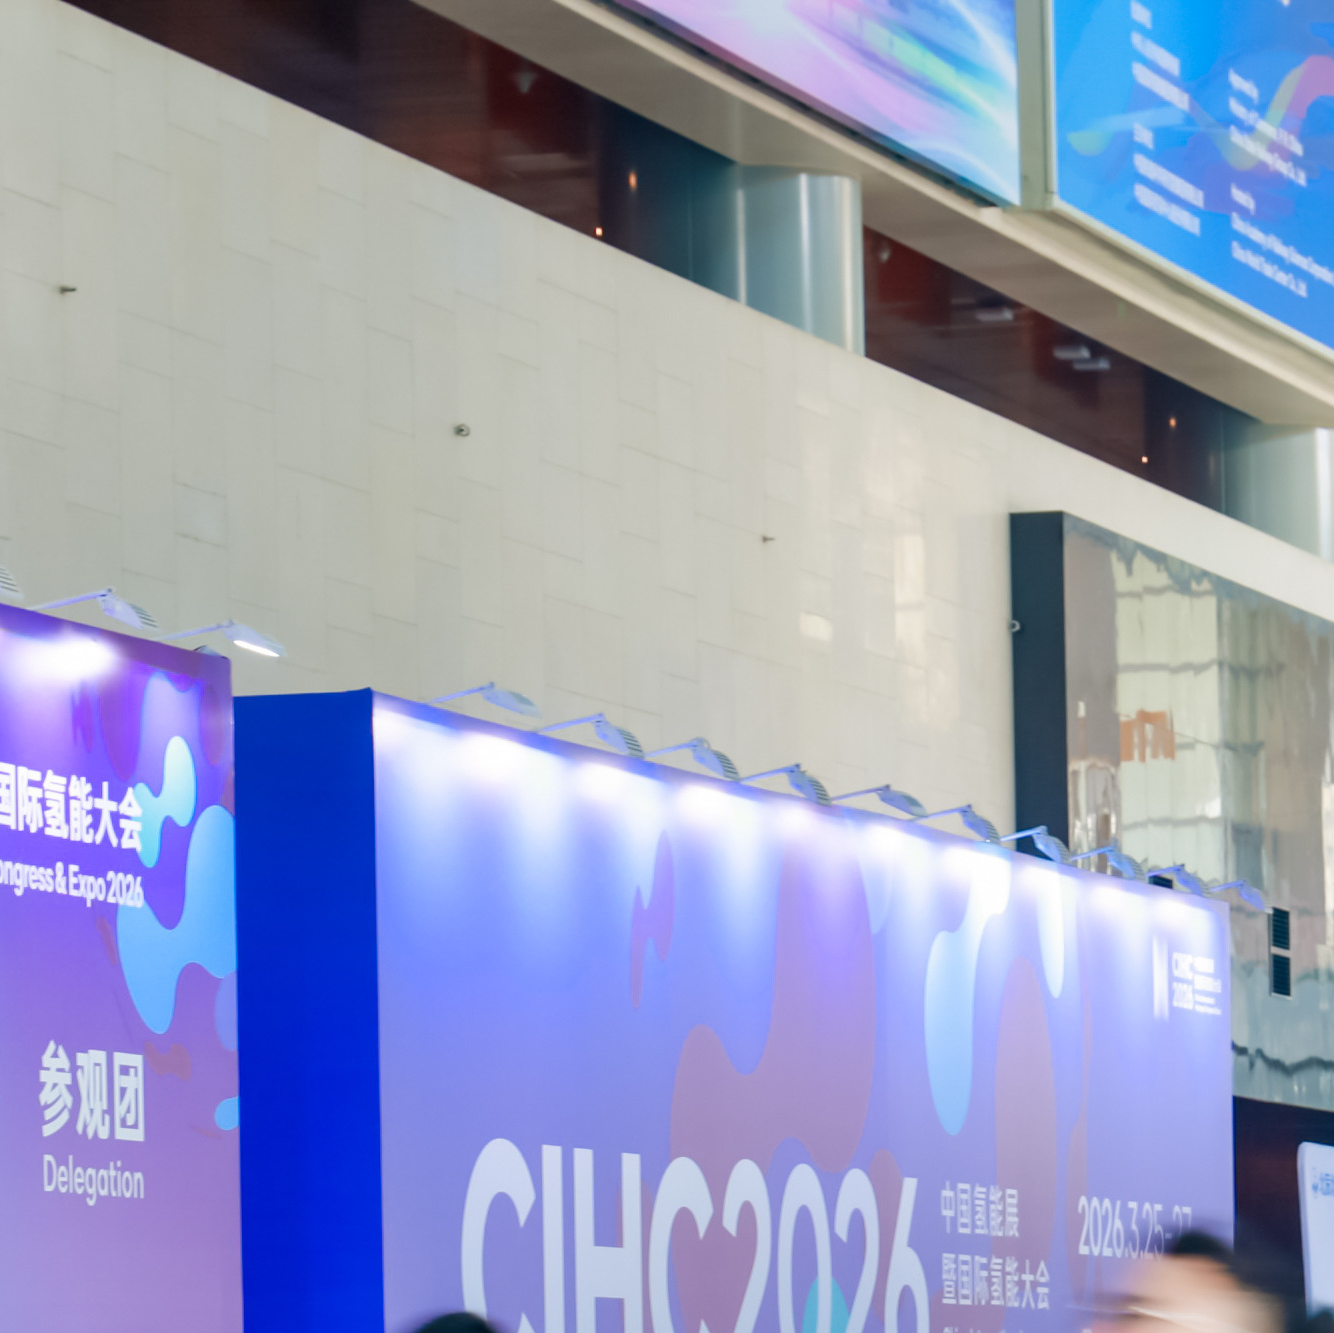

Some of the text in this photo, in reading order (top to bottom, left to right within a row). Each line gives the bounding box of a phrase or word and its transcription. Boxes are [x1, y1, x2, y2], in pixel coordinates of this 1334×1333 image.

[54, 870, 67, 894] &
[69, 872, 106, 907] Expo
[107, 876, 144, 907] 2026
[39, 1040, 145, 1142] 参观团
[43, 1154, 144, 1206] Delegation
[940, 1181, 1019, 1238] 中国氢能展
[941, 1252, 1050, 1310] 暨国际氢能大会
